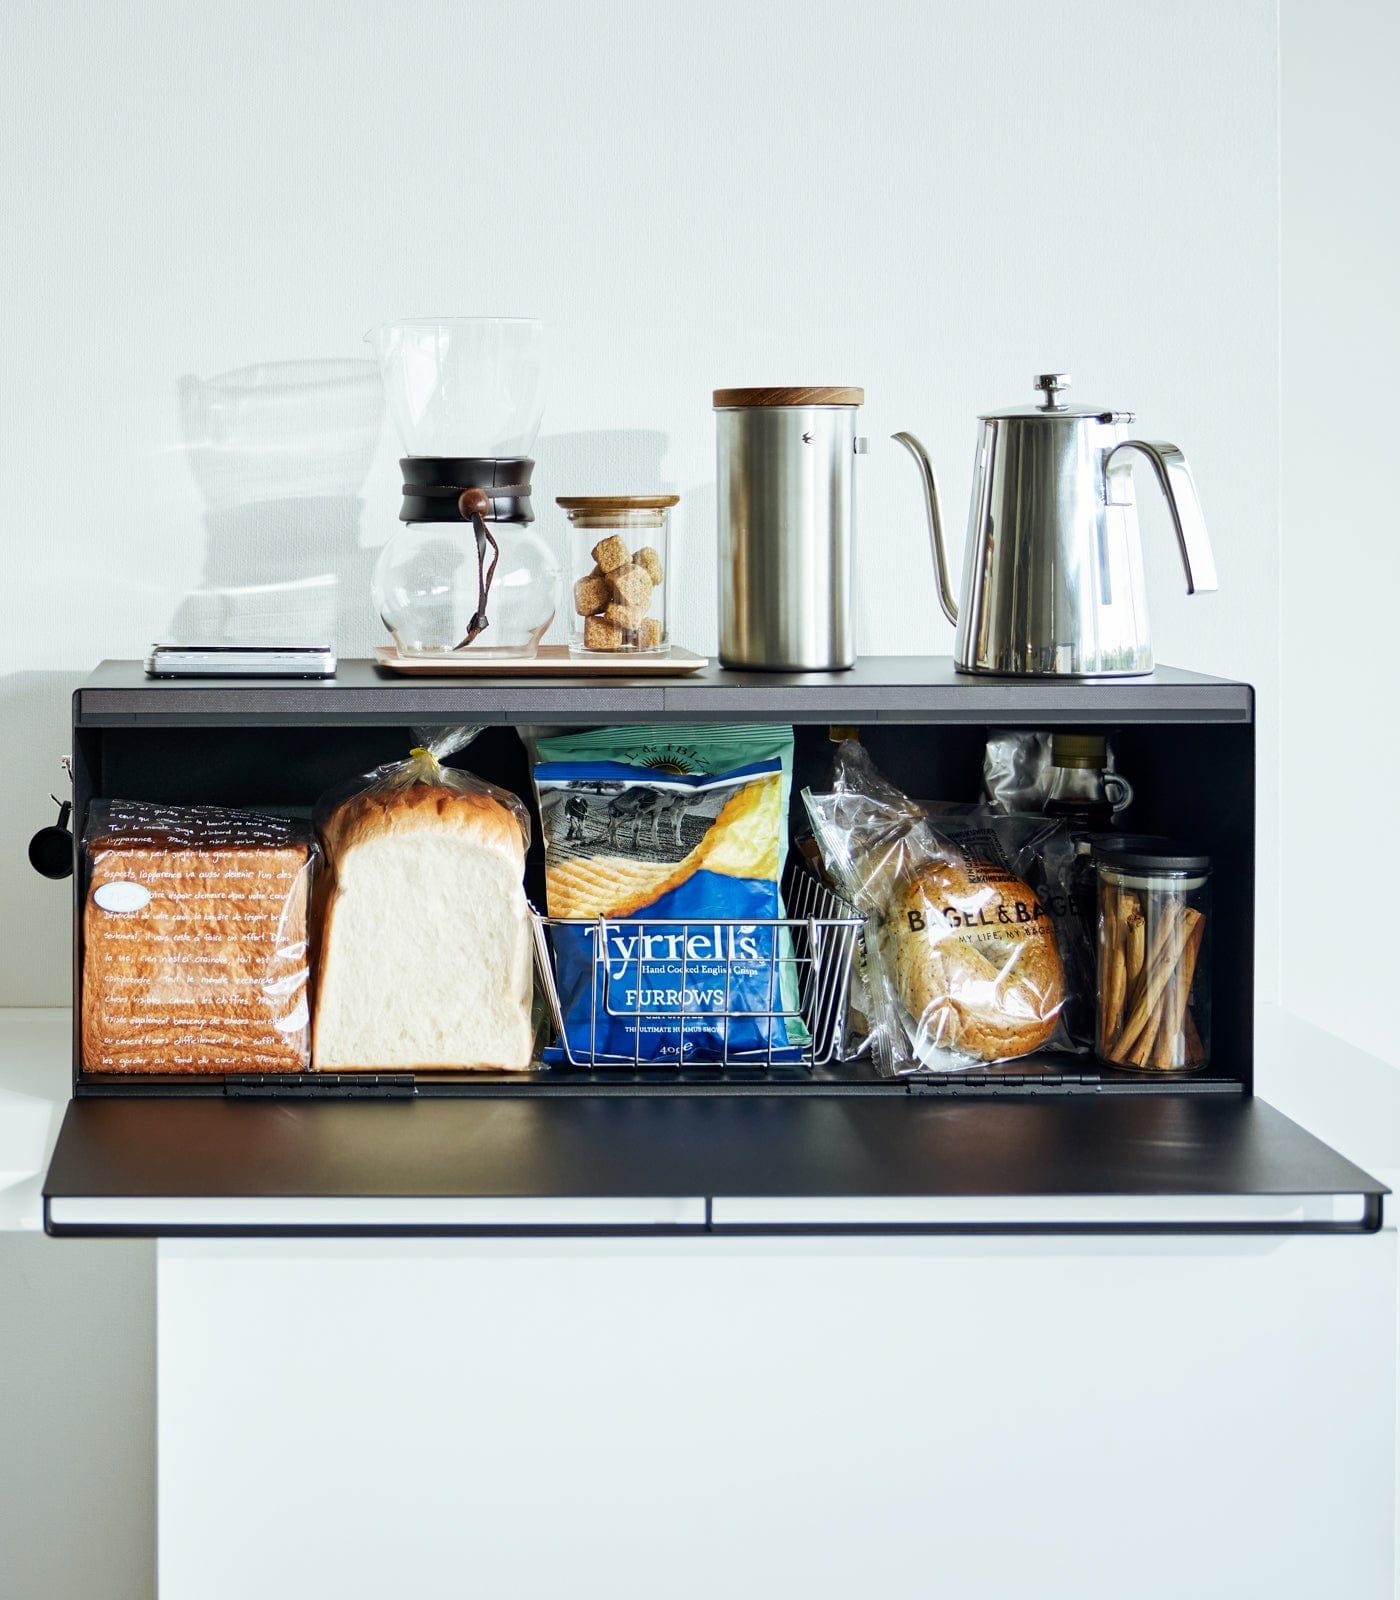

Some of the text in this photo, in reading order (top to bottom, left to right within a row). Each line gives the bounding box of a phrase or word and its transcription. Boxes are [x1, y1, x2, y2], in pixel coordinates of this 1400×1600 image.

[198, 869, 221, 879] aussi
[998, 905, 1014, 924] &
[1014, 893, 1081, 923] BAGE
[958, 935, 972, 944] MY
[641, 965, 665, 975] Hand
[733, 966, 759, 978] Crisps
[624, 989, 724, 1006] FURROWS
